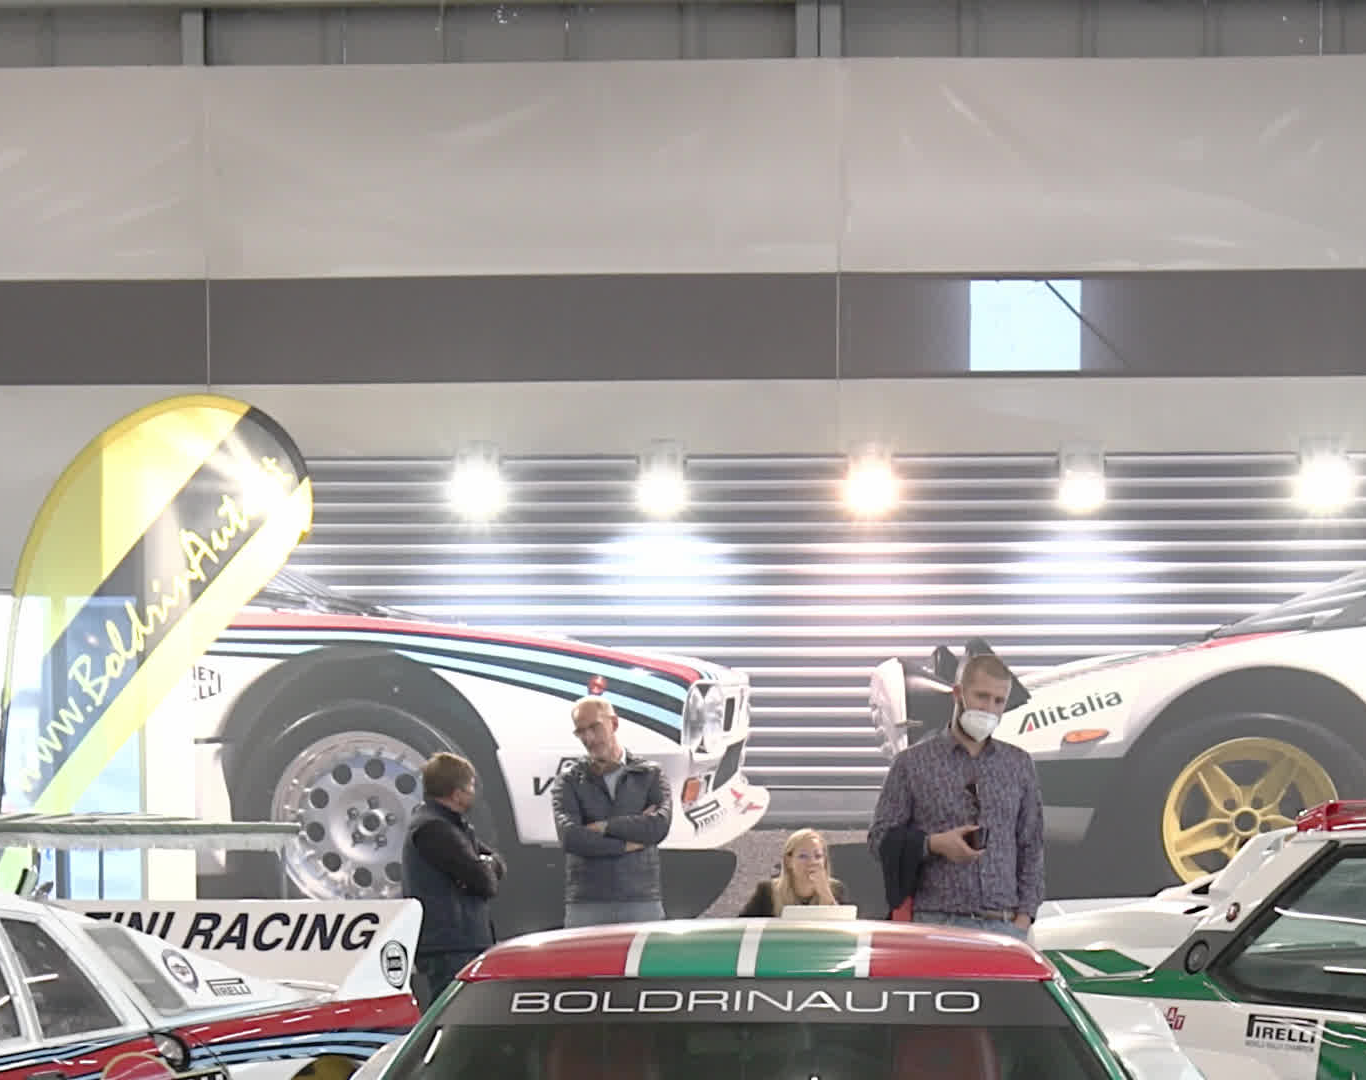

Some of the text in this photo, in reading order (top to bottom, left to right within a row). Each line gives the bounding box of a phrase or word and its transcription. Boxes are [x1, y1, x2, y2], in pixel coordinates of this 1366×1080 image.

[1018, 691, 1124, 735] Alitalia
[181, 913, 381, 951] RACING
[509, 990, 981, 1014] BOLDRINAUTO
[1245, 1014, 1319, 1044] PIRELLI
